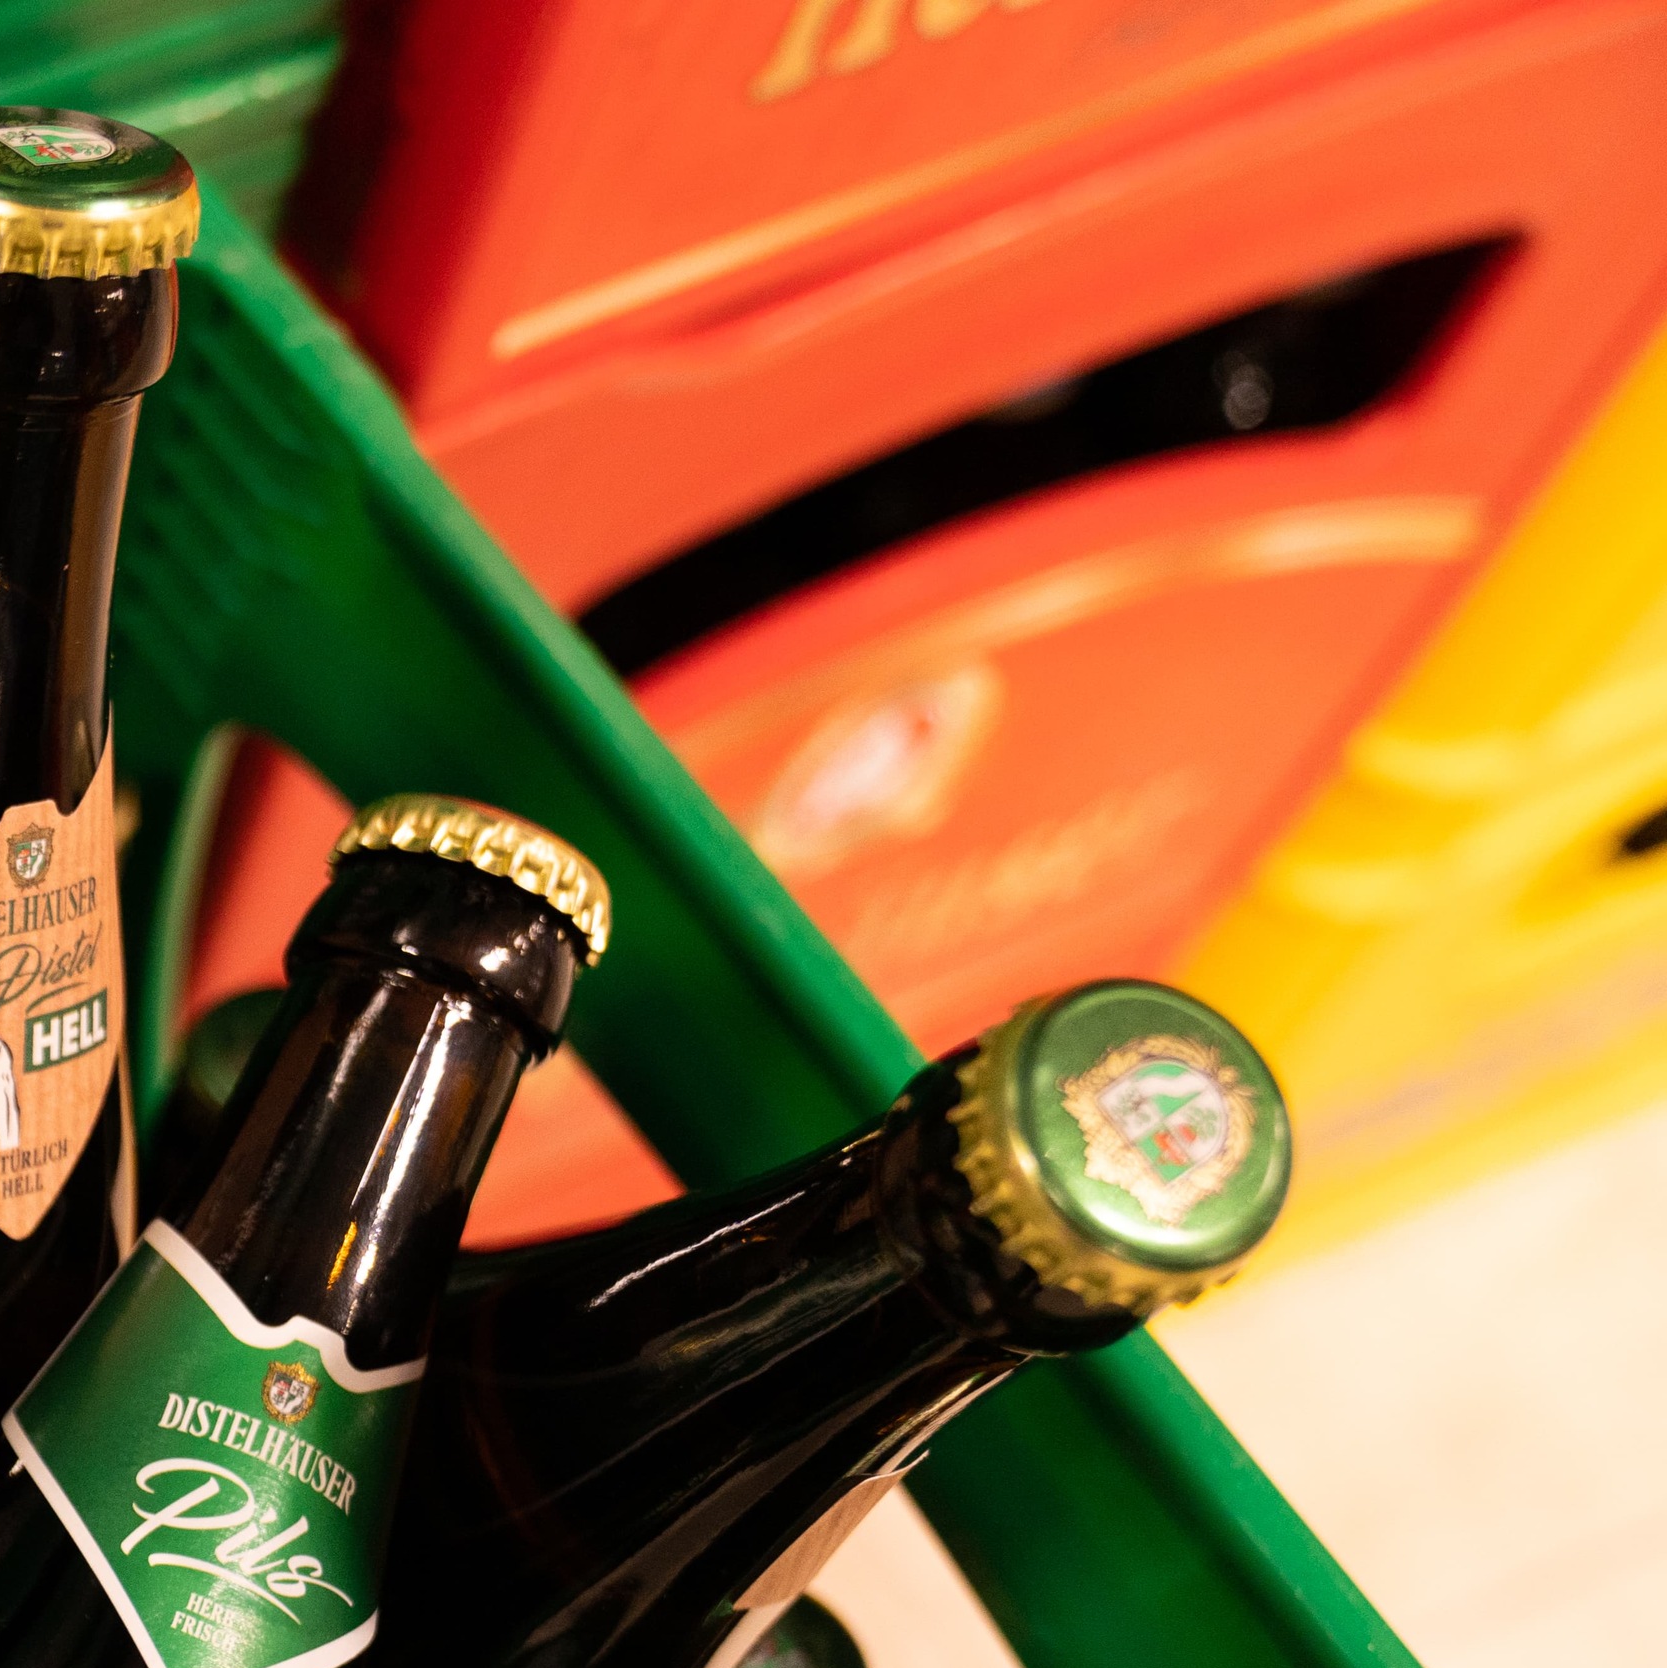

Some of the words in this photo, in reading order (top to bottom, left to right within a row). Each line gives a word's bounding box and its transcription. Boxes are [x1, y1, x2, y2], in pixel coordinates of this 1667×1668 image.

[31, 998, 107, 1068] HELL
[1, 1173, 44, 1200] HELL
[157, 1391, 357, 1517] DISTELHÄUSER
[120, 1456, 354, 1608] Pils
[170, 1610, 238, 1655] FRISCH
[186, 1592, 239, 1628] HERB
